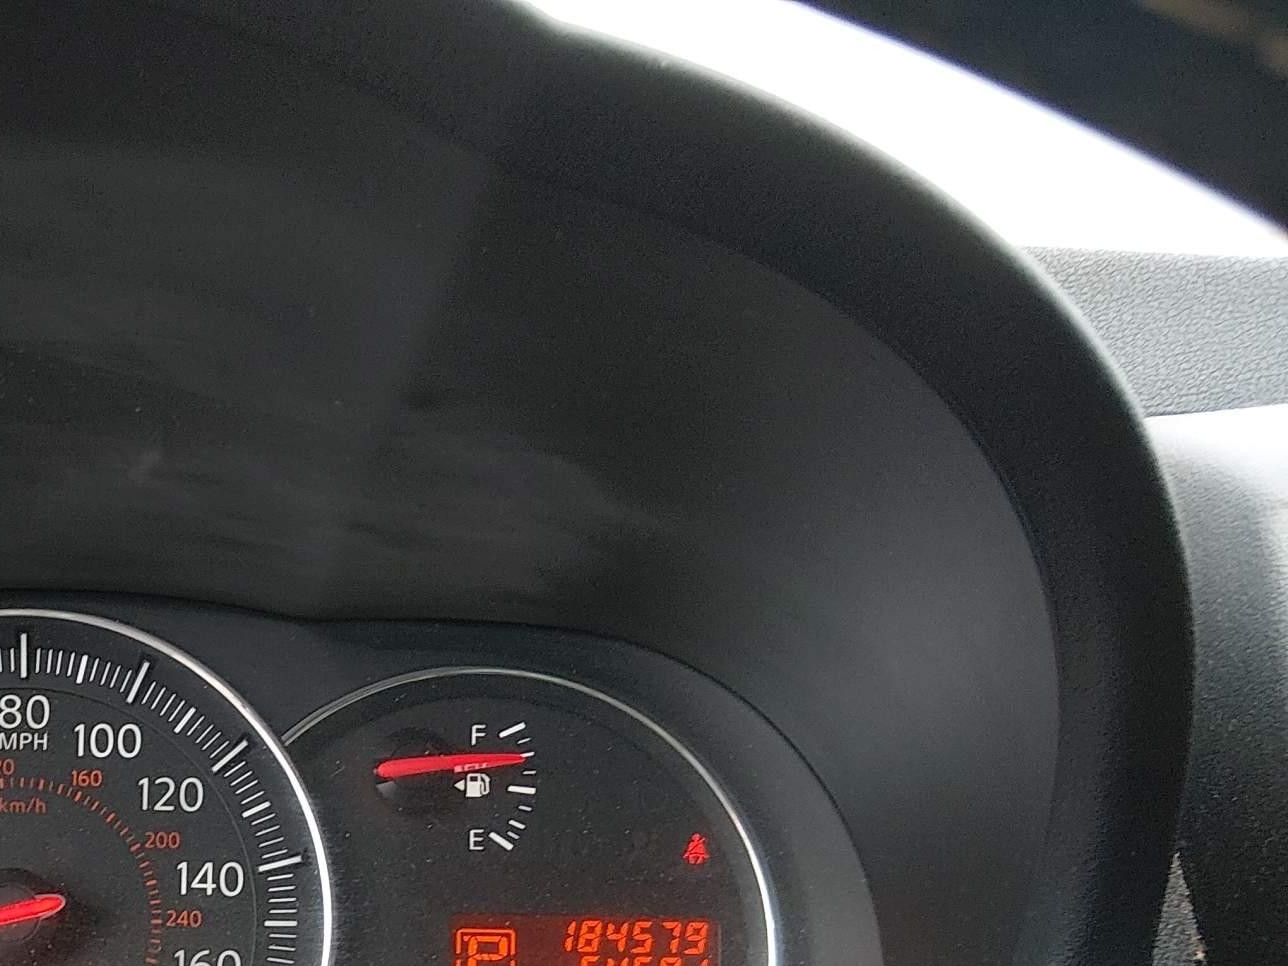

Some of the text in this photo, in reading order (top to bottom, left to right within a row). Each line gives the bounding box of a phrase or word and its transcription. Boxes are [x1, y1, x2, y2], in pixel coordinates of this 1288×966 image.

[0, 695, 50, 730] 80
[0, 732, 49, 751] MPH
[74, 724, 142, 758] 100
[471, 725, 486, 746] F
[71, 771, 102, 787] 160
[138, 778, 204, 812] 120
[145, 832, 180, 849] 200
[469, 829, 485, 850] E
[176, 862, 244, 897] 140
[166, 910, 203, 928] 240
[564, 920, 709, 954] 184579
